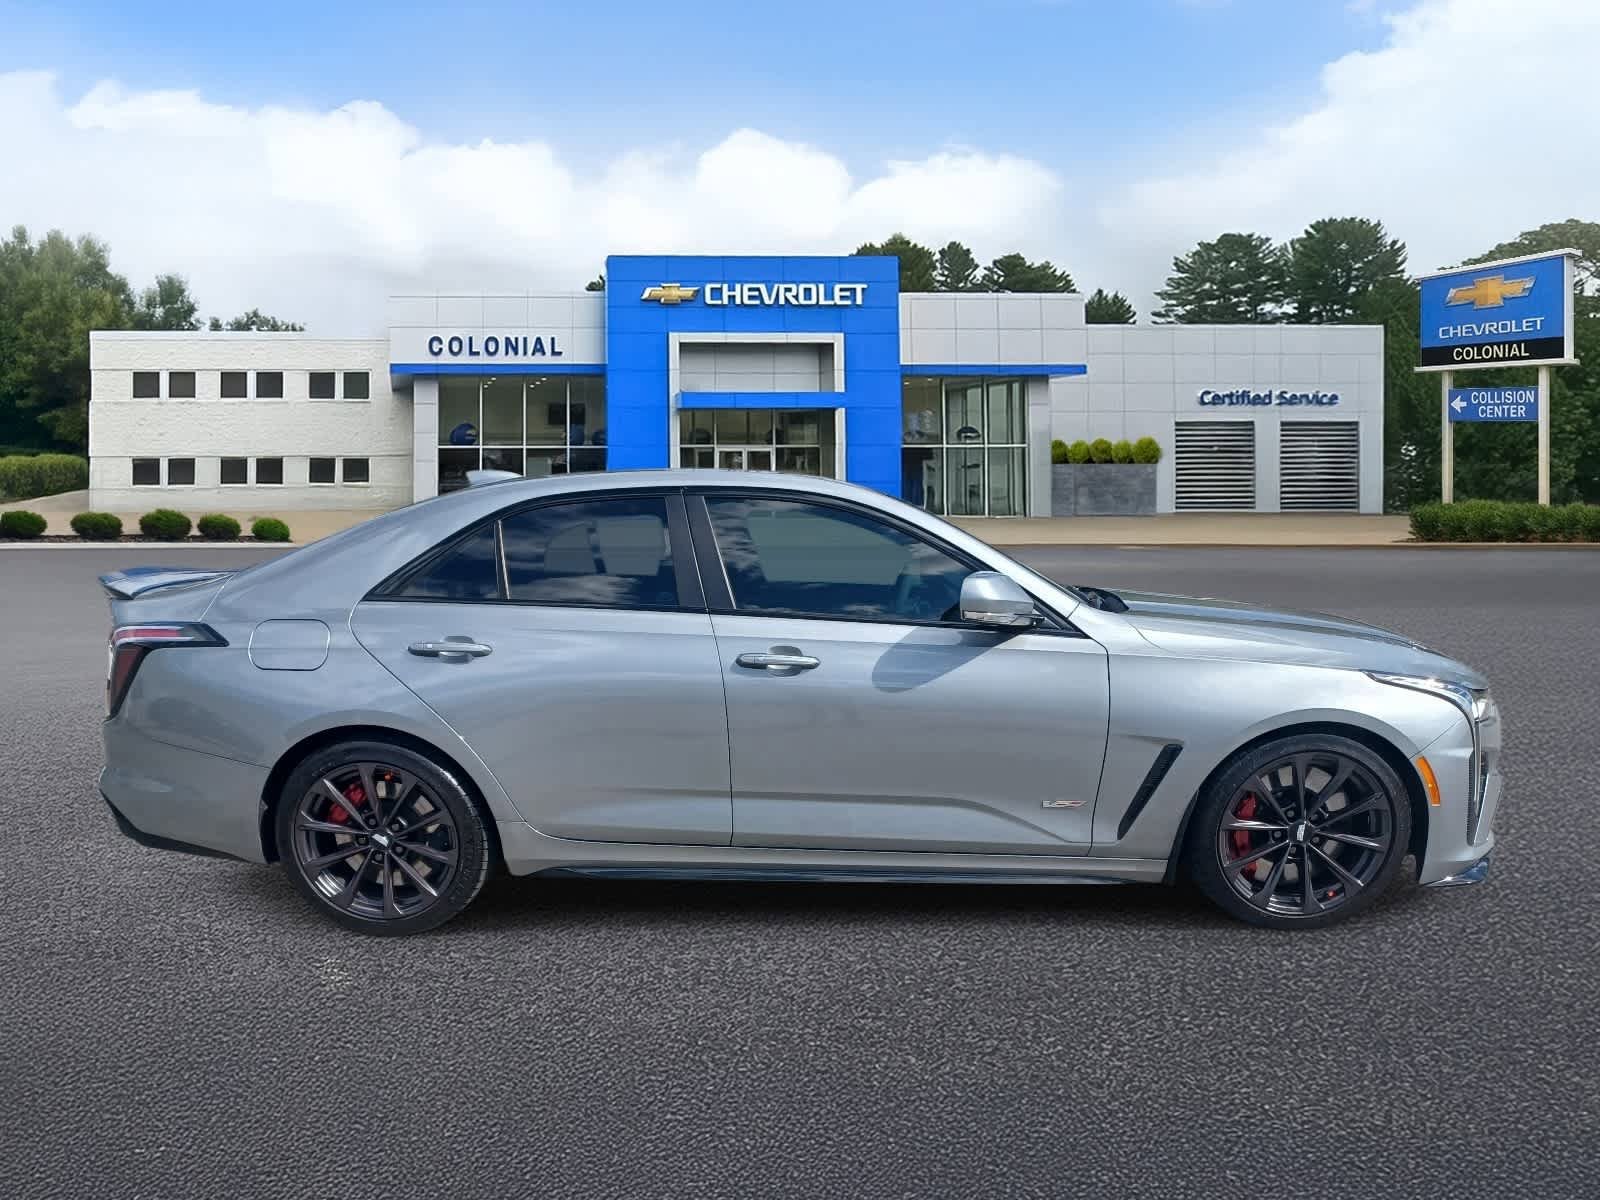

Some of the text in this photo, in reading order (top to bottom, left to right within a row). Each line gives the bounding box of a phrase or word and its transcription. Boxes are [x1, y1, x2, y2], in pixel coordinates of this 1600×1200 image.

[704, 283, 868, 306] CHEVROLET
[1438, 317, 1545, 339] CHEVROLET
[427, 335, 564, 357] COLONIAL
[1453, 342, 1530, 361] COLONIAL
[1199, 389, 1340, 406] Certified Service
[1471, 390, 1535, 404] COLLISION
[1478, 405, 1526, 418] CENTER
